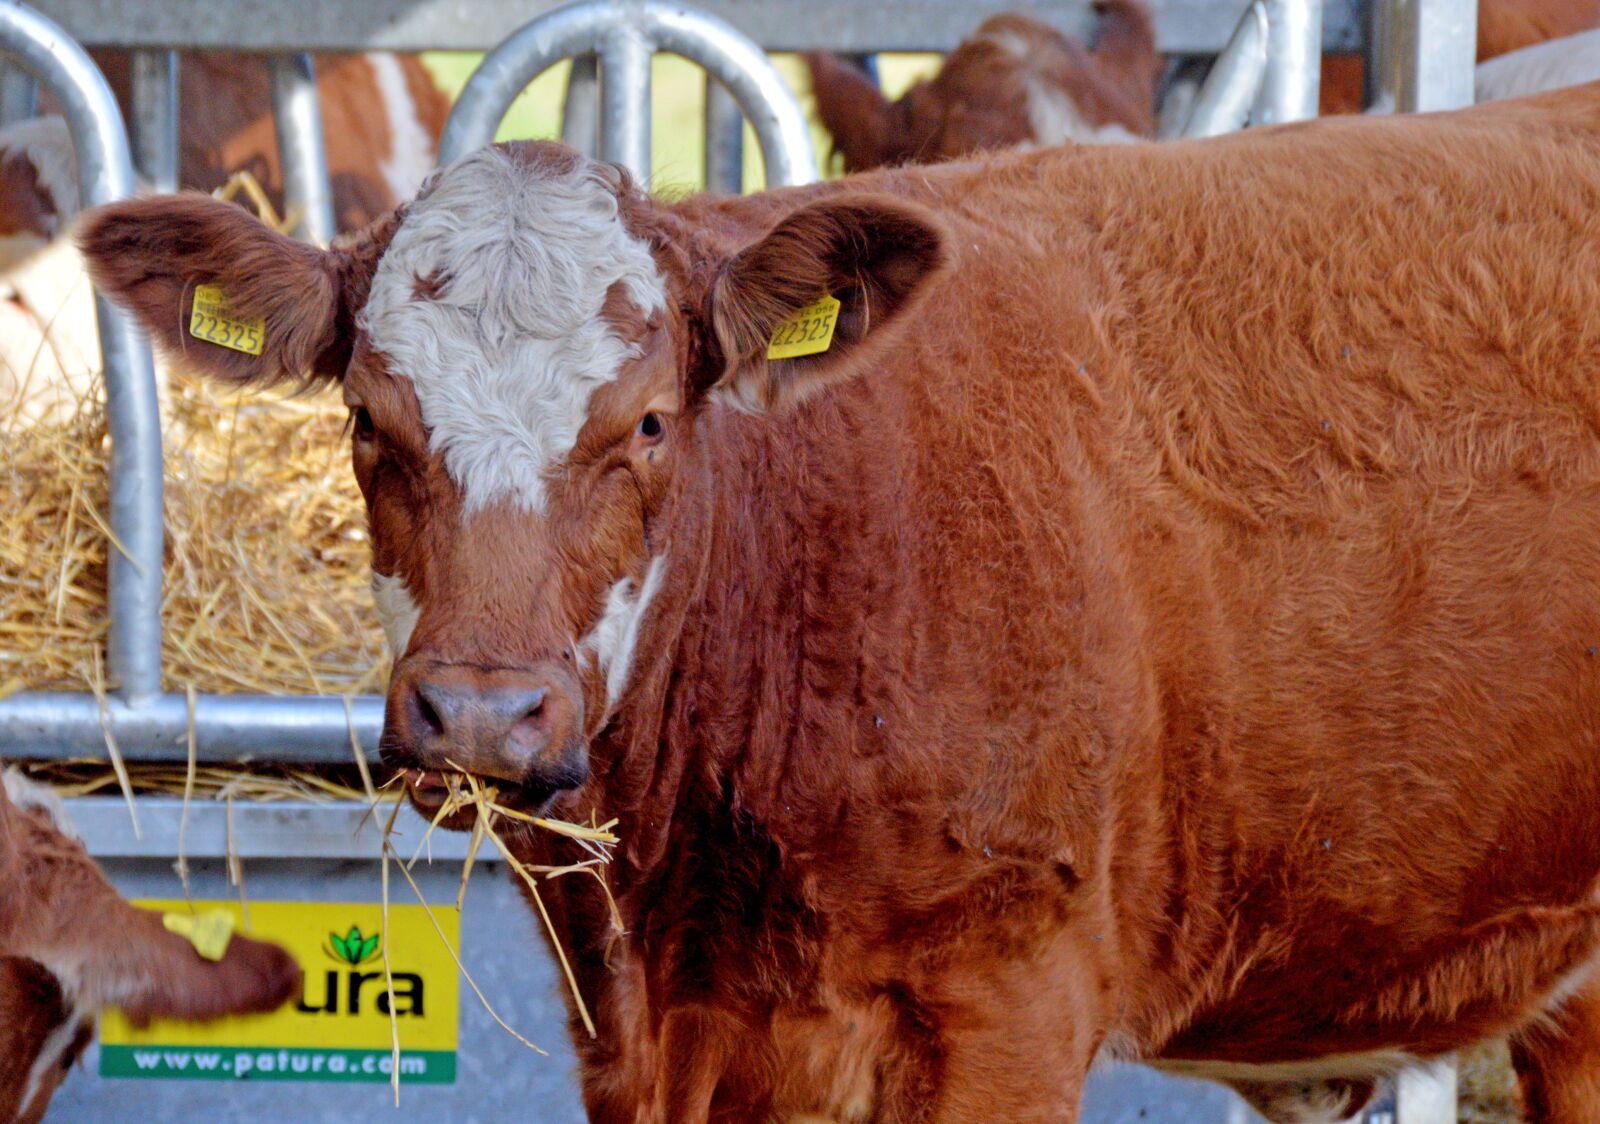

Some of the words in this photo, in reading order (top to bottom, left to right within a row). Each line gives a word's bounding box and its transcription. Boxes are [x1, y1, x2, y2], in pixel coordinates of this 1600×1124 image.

[193, 312, 259, 351] 22325
[771, 313, 834, 347] 22325
[295, 970, 425, 1017] ura
[133, 1049, 427, 1077] www.patura.com
